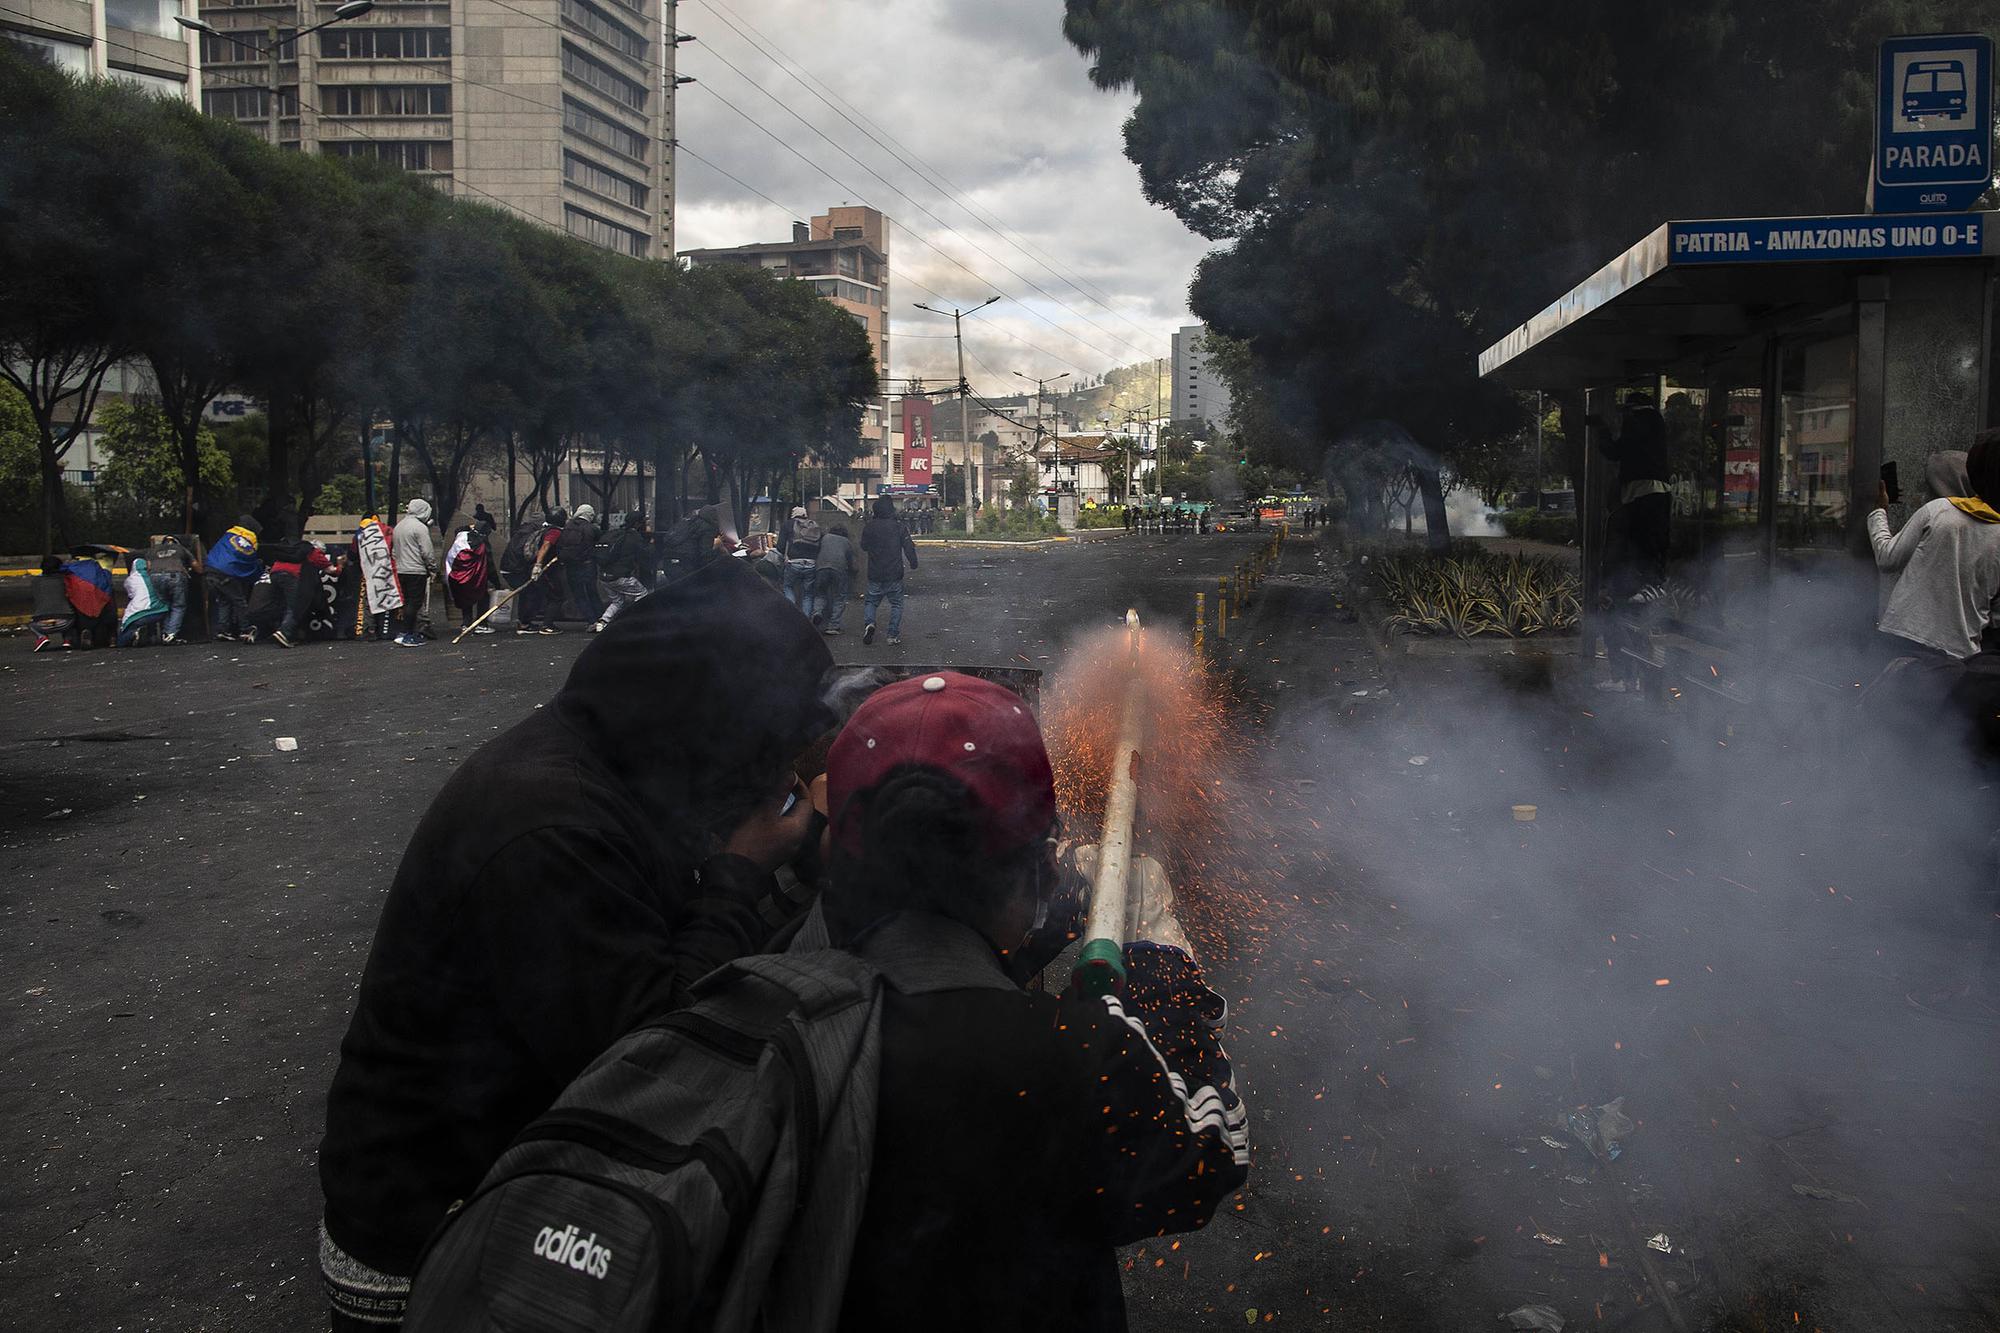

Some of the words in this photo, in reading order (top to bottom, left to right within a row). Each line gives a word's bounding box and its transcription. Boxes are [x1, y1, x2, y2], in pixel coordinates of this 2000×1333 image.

[1885, 144, 1982, 169] PARADA
[1675, 232, 1750, 253] PATRIA
[1767, 228, 1886, 251] AMAZONAS
[1891, 226, 1937, 247] UNO
[1942, 225, 1978, 245] O-E
[910, 458, 928, 470] KFC
[533, 1224, 613, 1280] adidas
